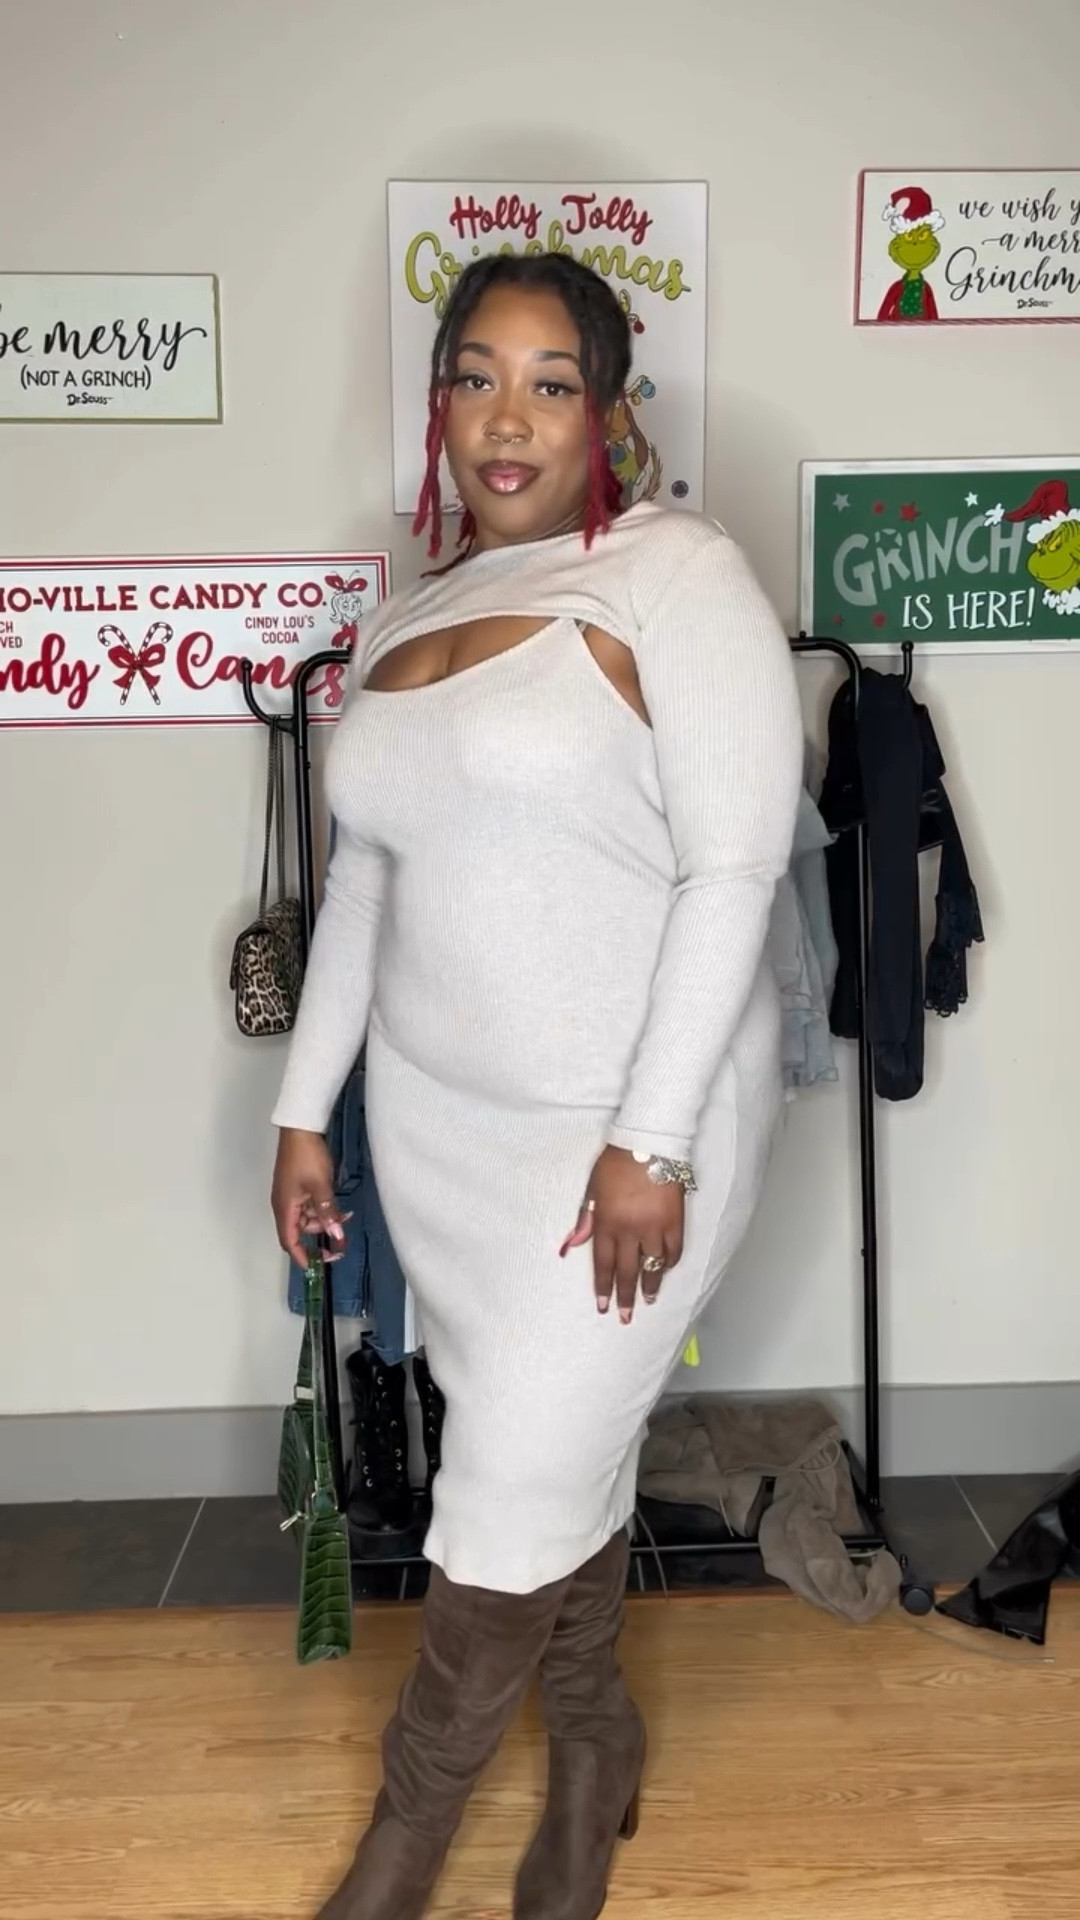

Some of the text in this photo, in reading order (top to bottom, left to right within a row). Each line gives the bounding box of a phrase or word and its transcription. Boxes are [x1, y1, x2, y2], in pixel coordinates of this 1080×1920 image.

[449, 193, 653, 245] Holly Jolly
[959, 199, 994, 219] we
[1002, 187, 1060, 223] wish
[945, 246, 1080, 301] Grinchm
[43, 317, 207, 371] merry
[21, 364, 151, 390] (NOT A GRINCH)
[833, 515, 1027, 607] GRINCH
[0, 582, 327, 612] O-VILLE CANDY CO.
[902, 587, 1036, 630] IS HERE!
[245, 614, 315, 629] CINDY LOU'S
[261, 631, 300, 644] COCOA
